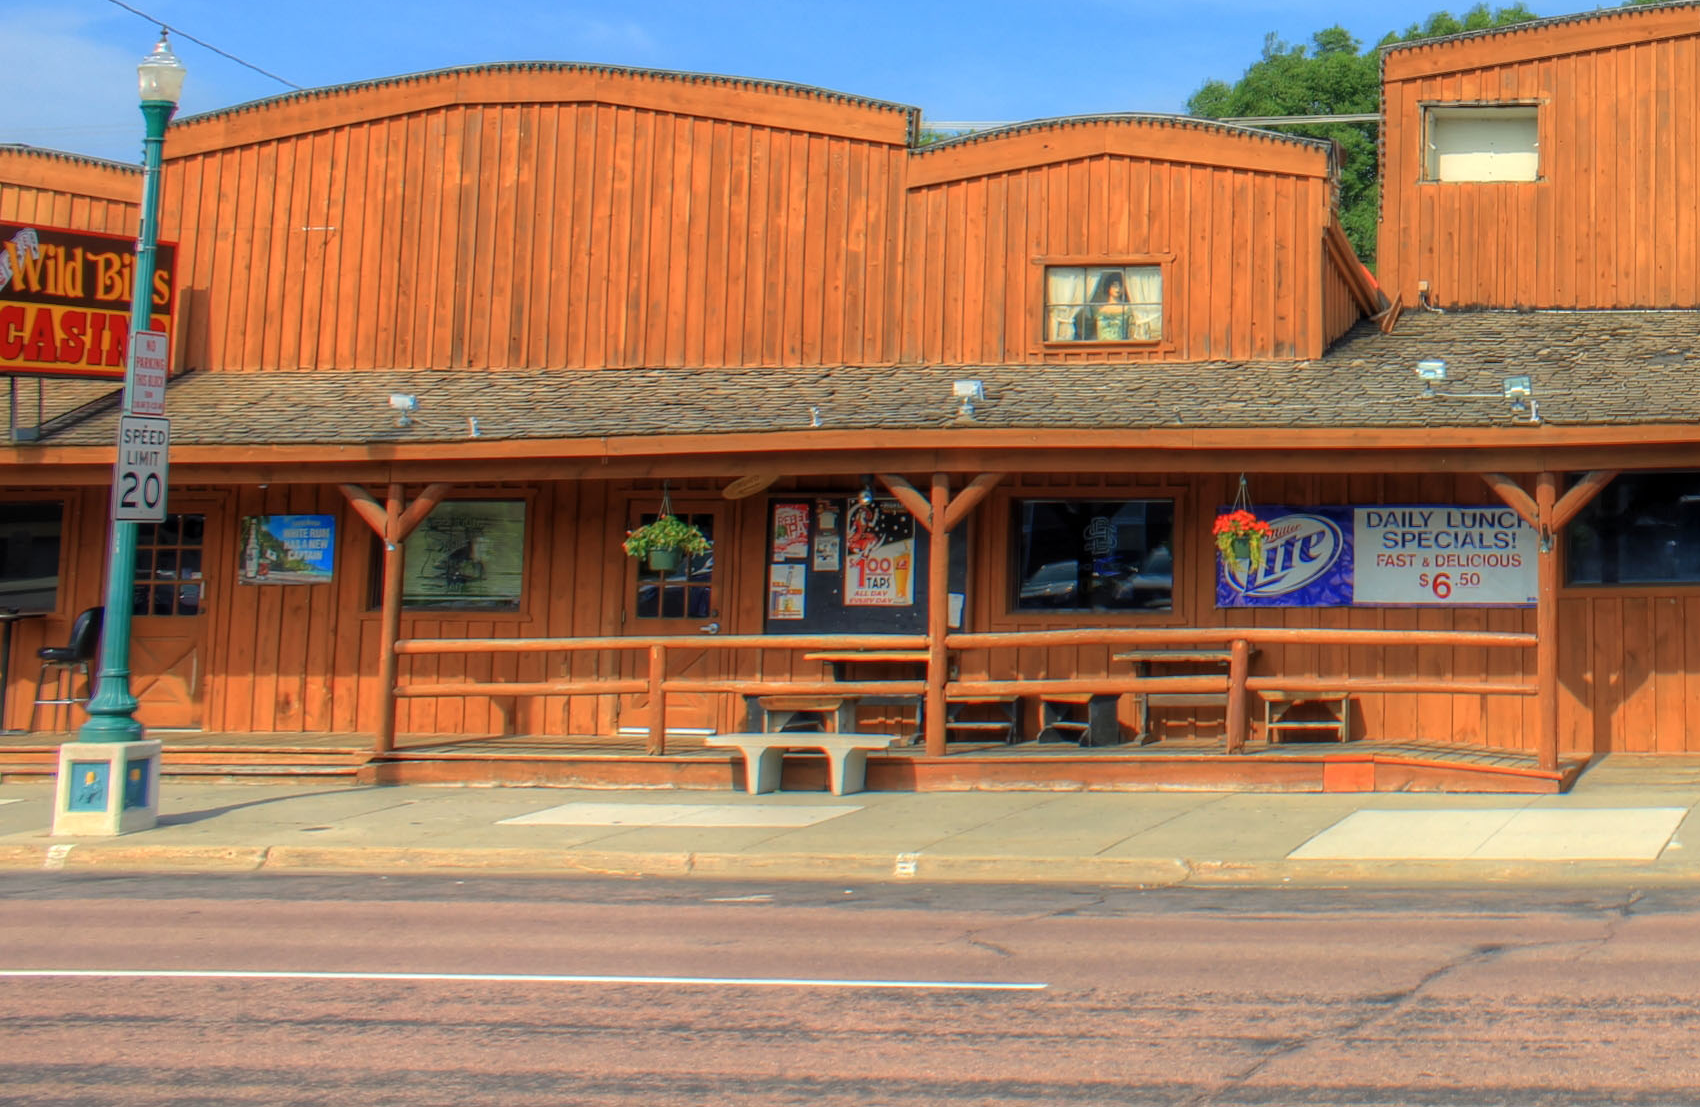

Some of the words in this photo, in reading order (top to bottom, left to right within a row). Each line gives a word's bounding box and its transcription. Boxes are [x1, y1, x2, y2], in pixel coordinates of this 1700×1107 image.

[5, 242, 84, 299] Wild
[136, 356, 165, 370] PARKING
[124, 429, 165, 445] SPEED
[127, 450, 160, 466] LIMIT
[121, 472, 161, 508] 20
[1366, 511, 1434, 529] DAILY
[309, 527, 330, 538] RUM
[1383, 530, 1517, 550] SPECIALS!
[309, 539, 328, 549] NEW
[1376, 553, 1416, 567] FAST
[1422, 556, 1431, 567] &
[1435, 553, 1522, 568] DELICIOUS
[867, 577, 890, 589] TAPS
